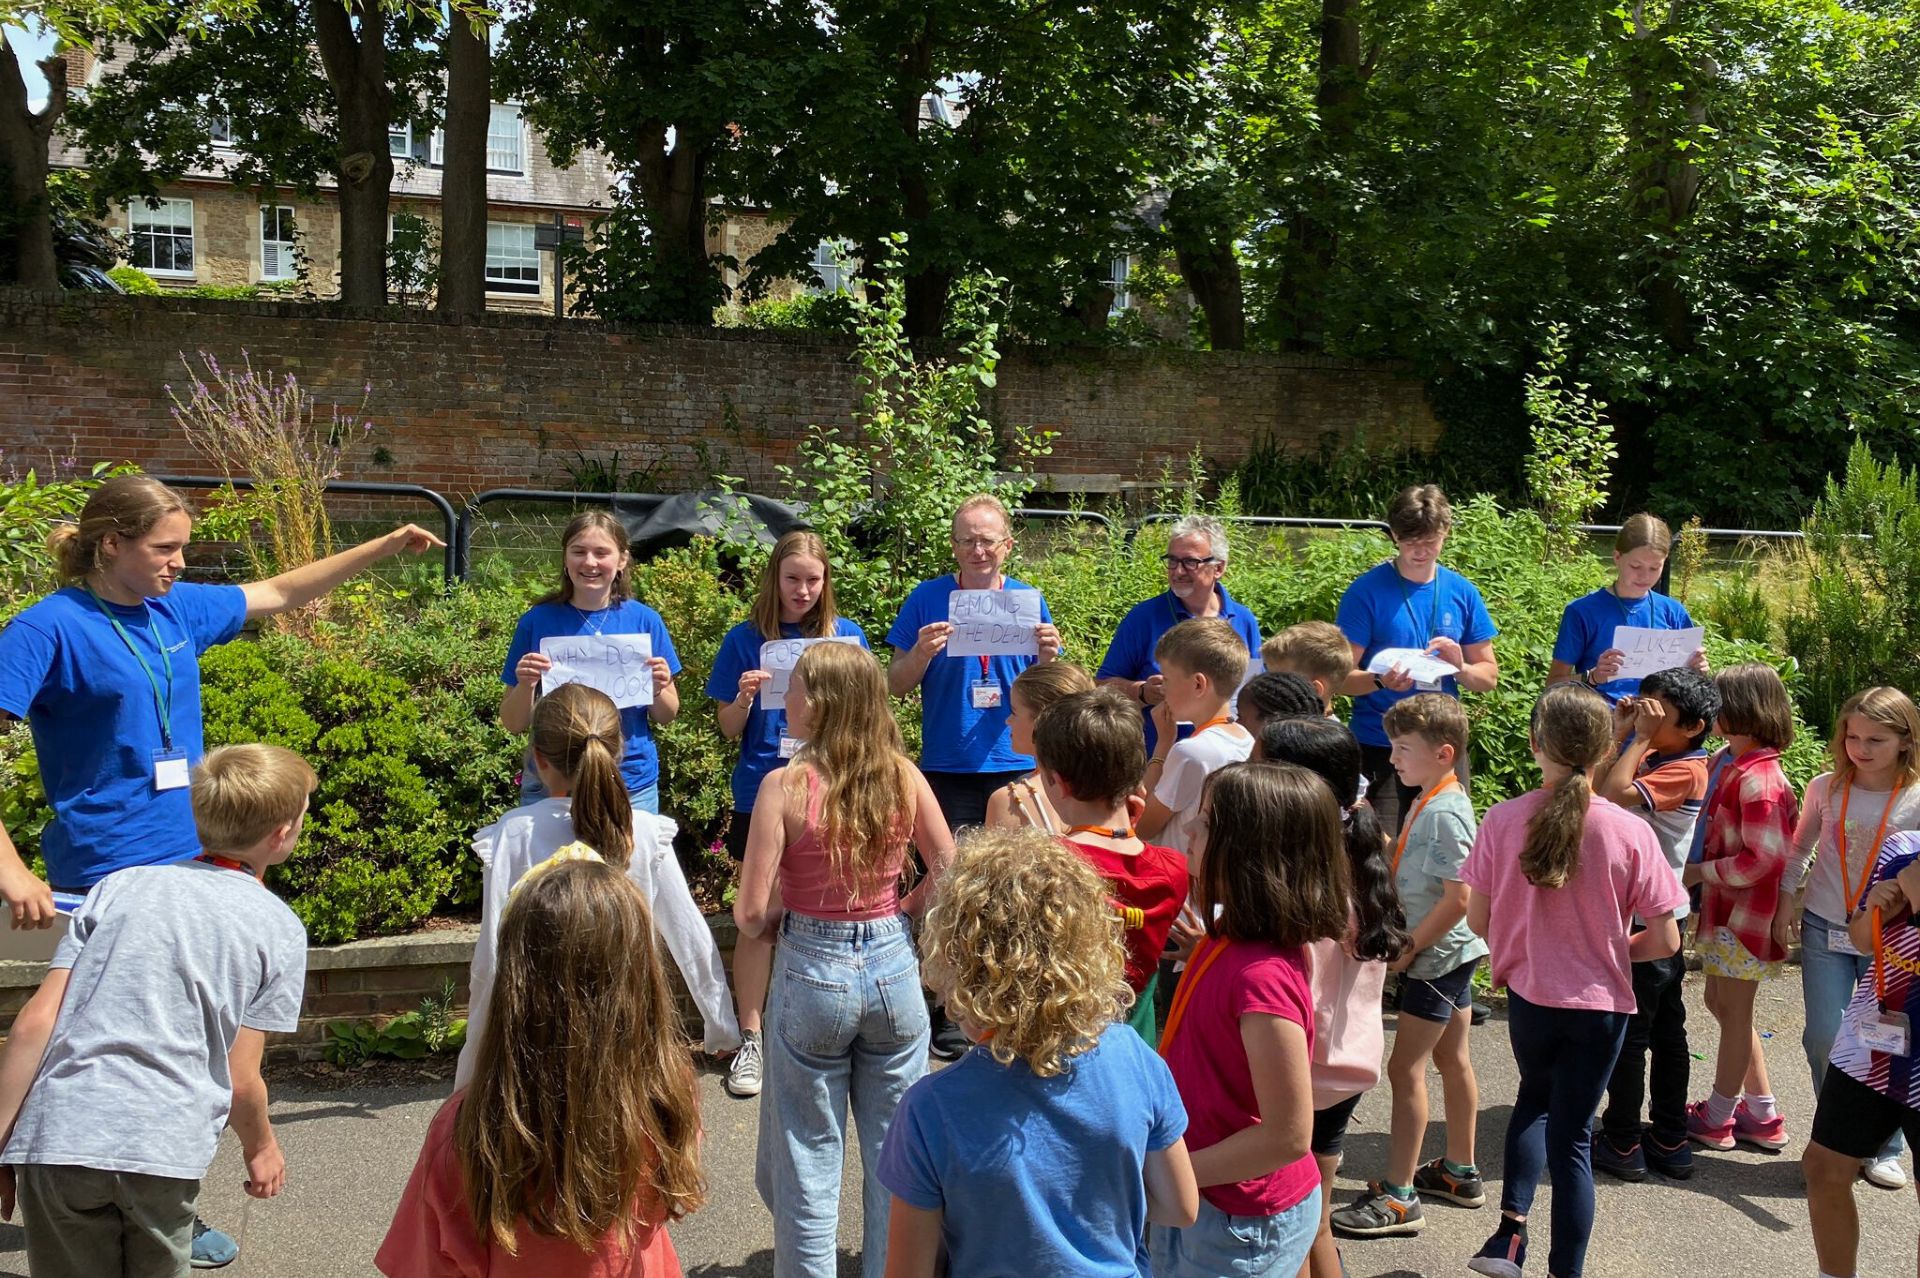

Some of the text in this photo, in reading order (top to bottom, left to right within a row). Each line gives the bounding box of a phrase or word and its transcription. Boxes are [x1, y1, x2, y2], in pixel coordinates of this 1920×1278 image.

[954, 595, 1020, 615] AMONG
[955, 622, 984, 641] THE
[764, 641, 803, 663] FOR
[1633, 634, 1685, 653] LUKE
[605, 644, 635, 666] DO
